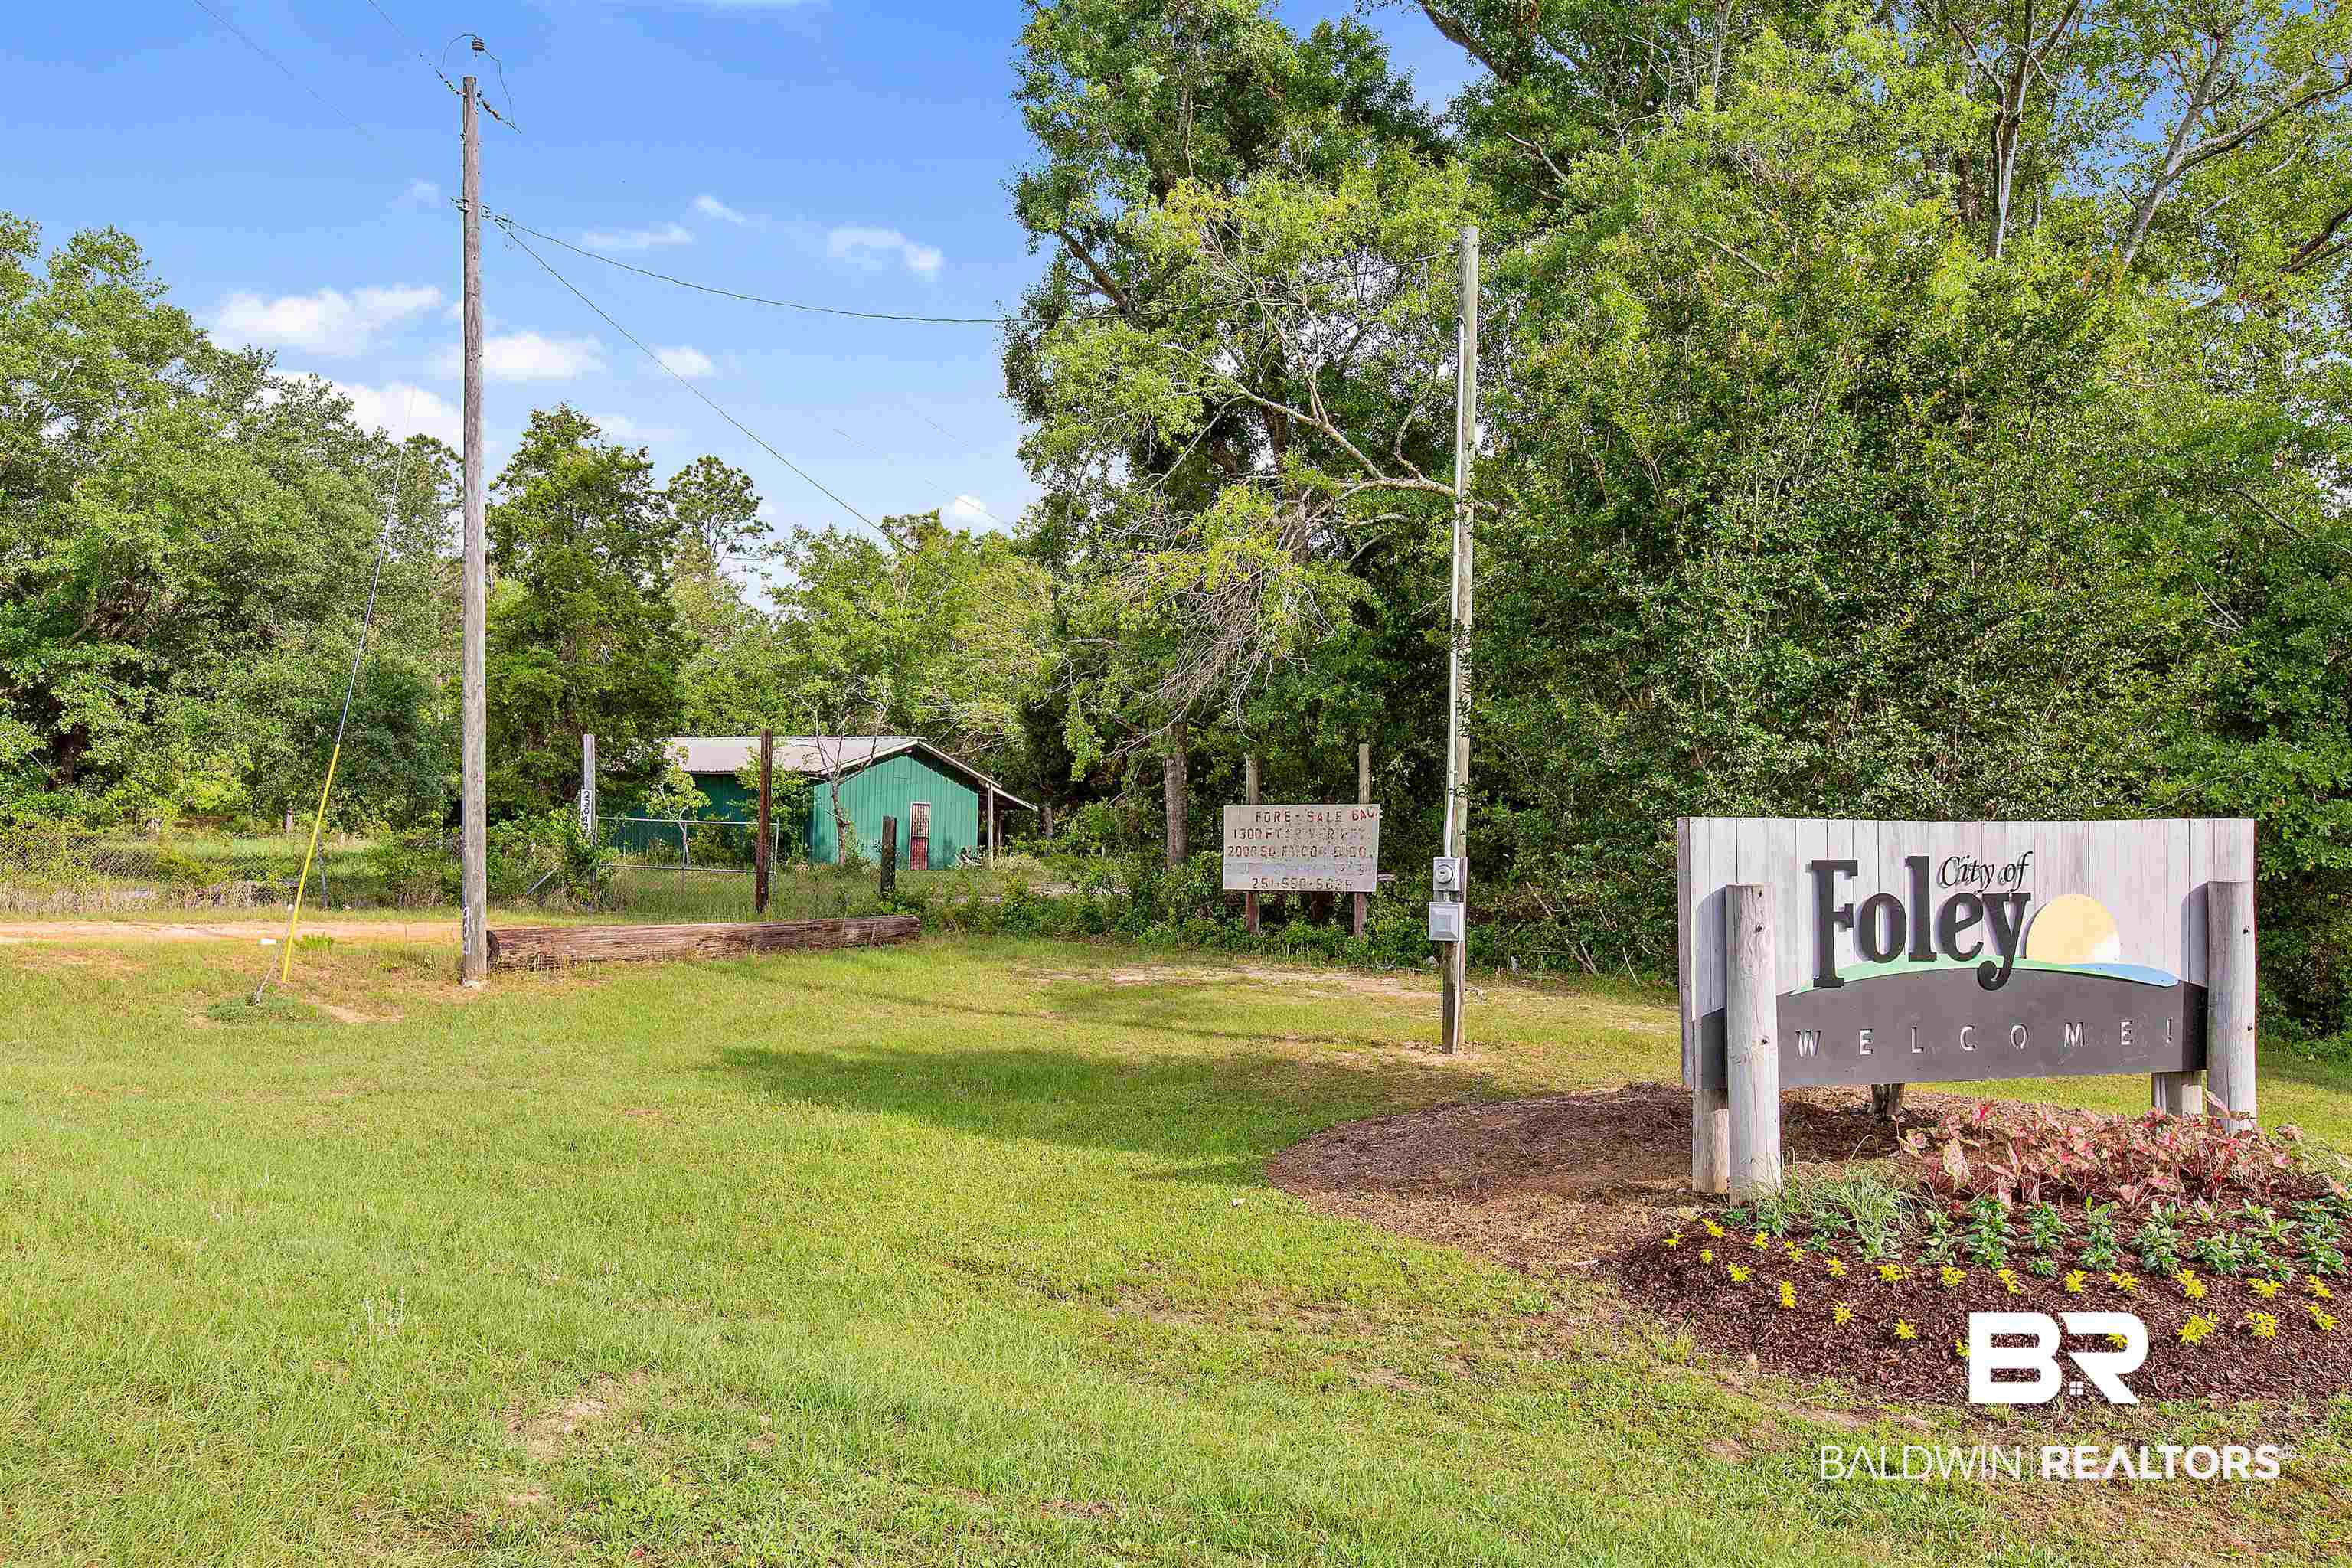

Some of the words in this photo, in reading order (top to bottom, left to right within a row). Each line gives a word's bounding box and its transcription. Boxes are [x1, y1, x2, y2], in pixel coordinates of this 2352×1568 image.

[1256, 810, 1291, 822] FORE
[1306, 810, 1342, 822] SALE
[1940, 854, 1995, 895] City
[2004, 851, 2034, 893] of
[1810, 855, 2032, 991] Foley
